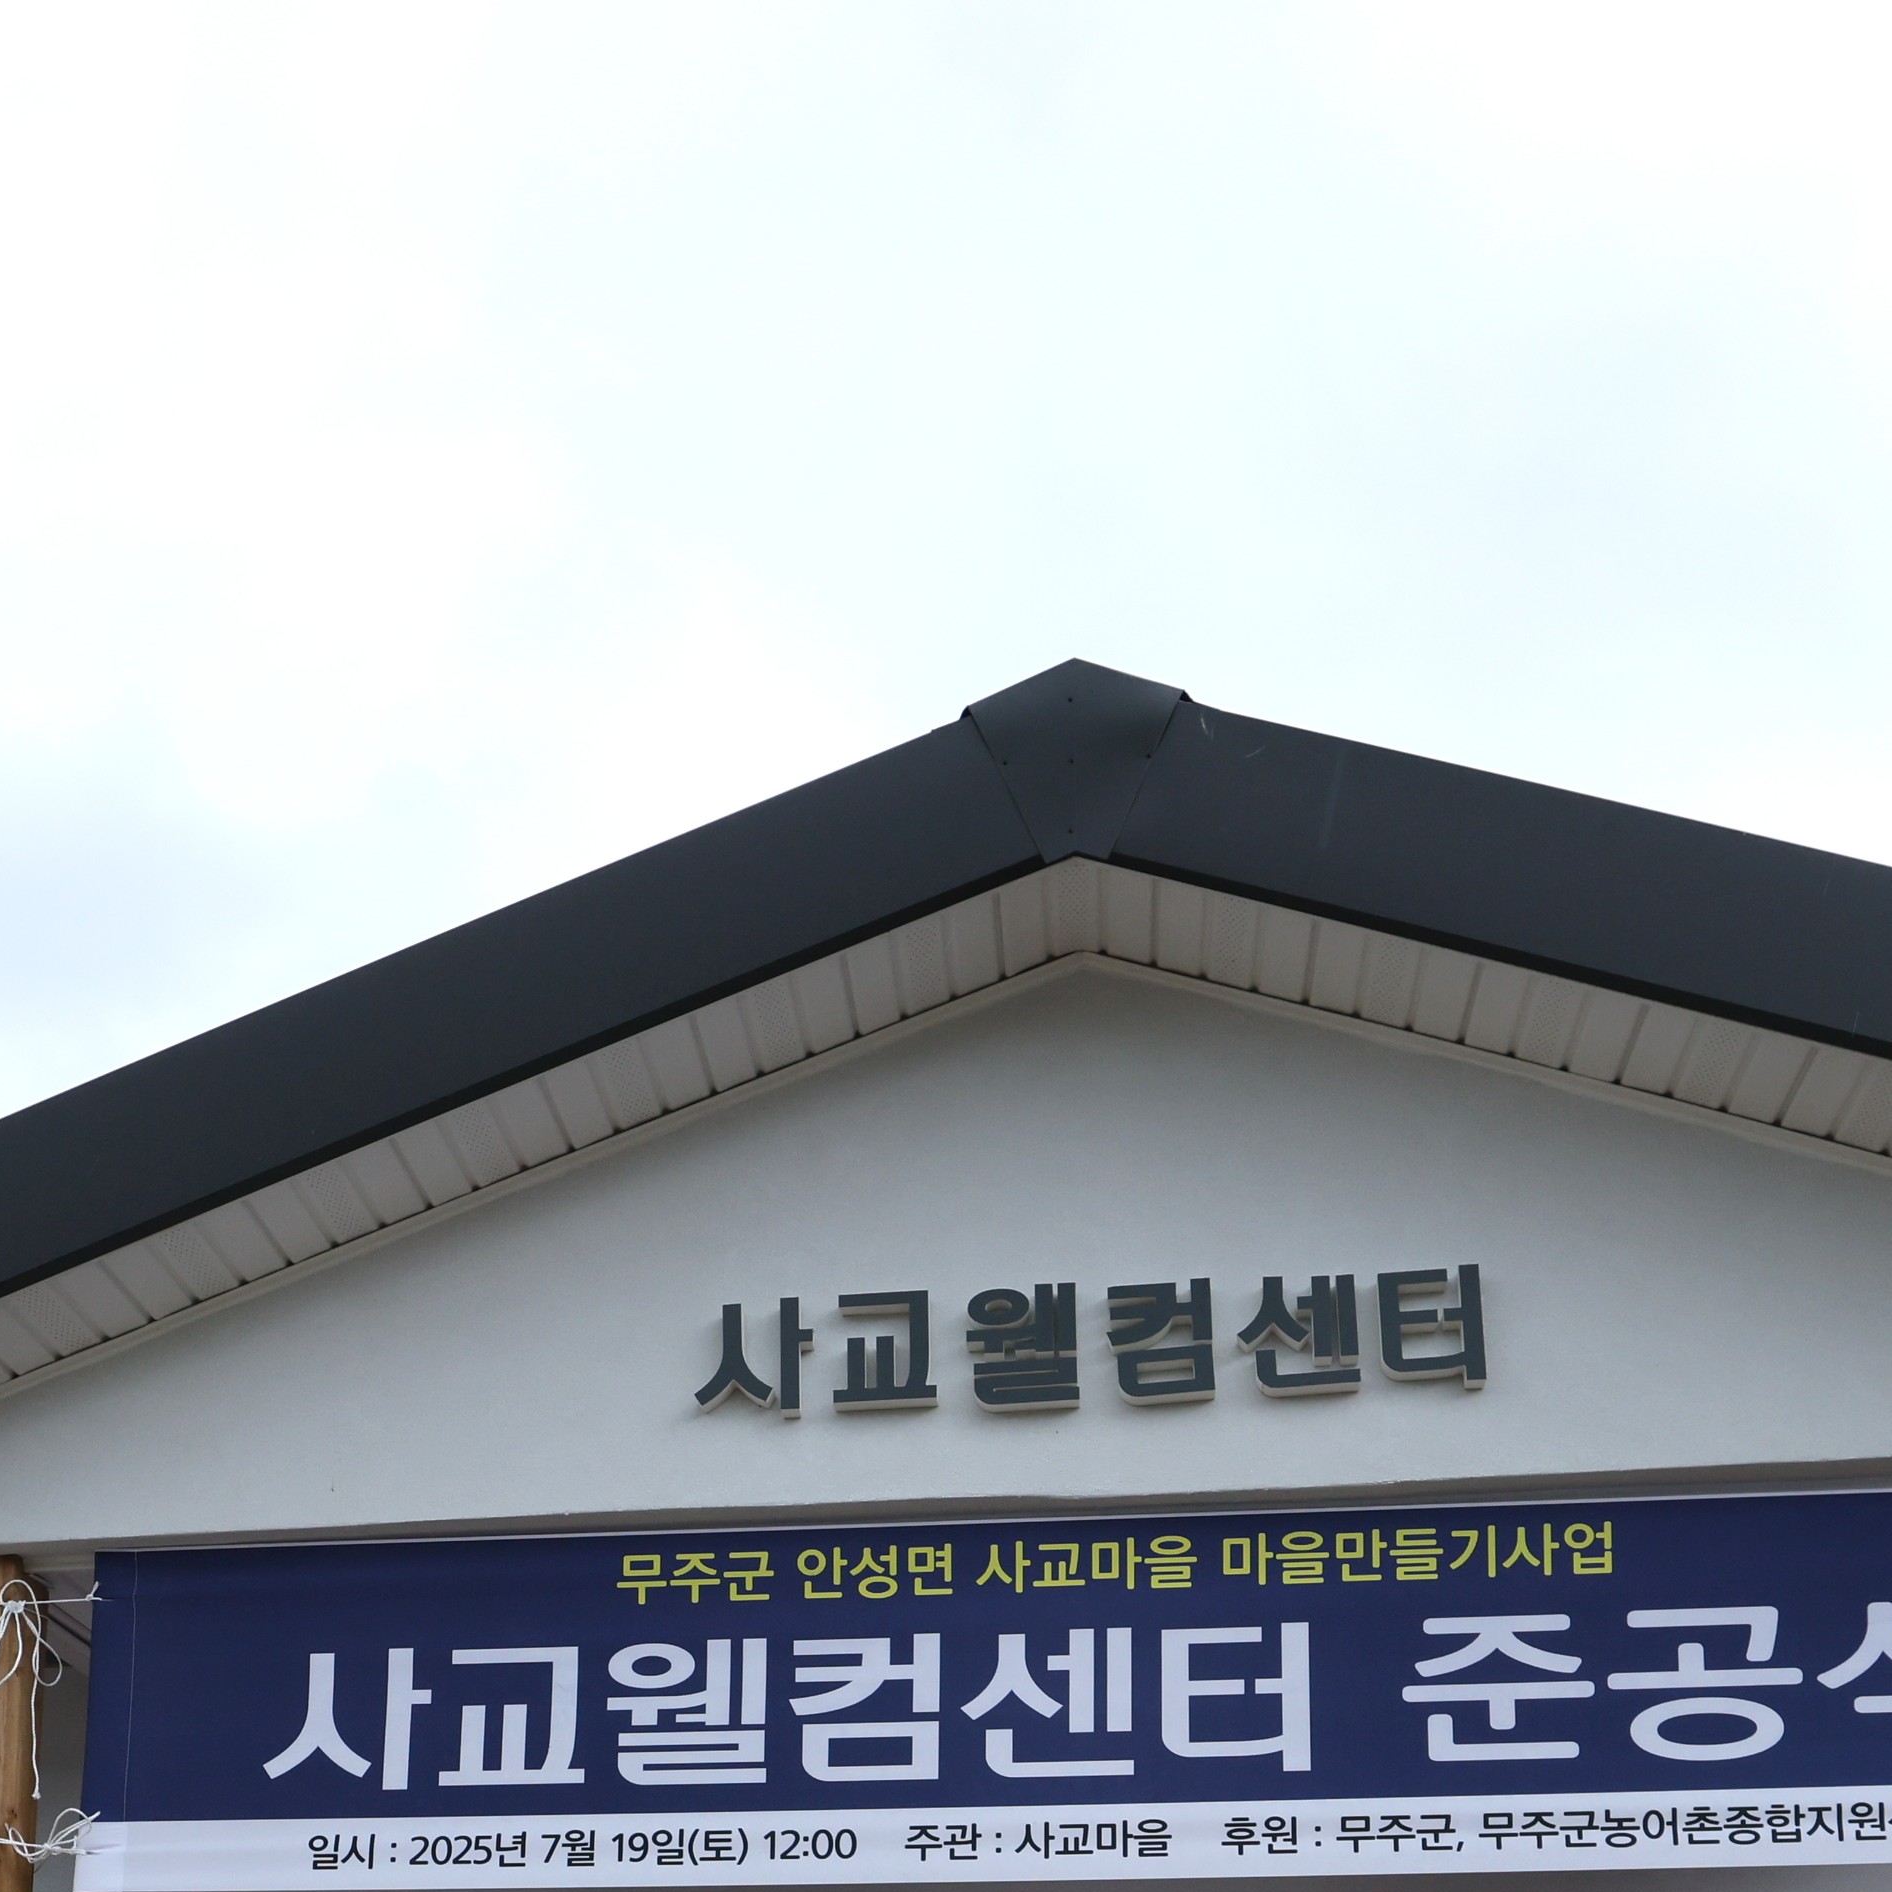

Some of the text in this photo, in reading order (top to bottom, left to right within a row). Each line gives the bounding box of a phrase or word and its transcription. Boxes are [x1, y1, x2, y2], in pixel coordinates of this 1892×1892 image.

[694, 1263, 1488, 1420] 사교웰컴센터
[616, 1521, 1614, 1604] 무주군 안성면 사교마을 마을만들기사업
[262, 1621, 1312, 1790] 사교웰컴센터
[308, 1833, 376, 1871] 일시
[409, 1831, 527, 1868] 2025년
[541, 1829, 596, 1867] 7월
[611, 1827, 749, 1866] 19일(토)
[763, 1828, 858, 1861] 12:00
[904, 1822, 983, 1862] 주관
[1014, 1818, 1173, 1860] 사교마을
[1221, 1816, 1298, 1856] 후원
[1335, 1814, 1464, 1854] 무주군,
